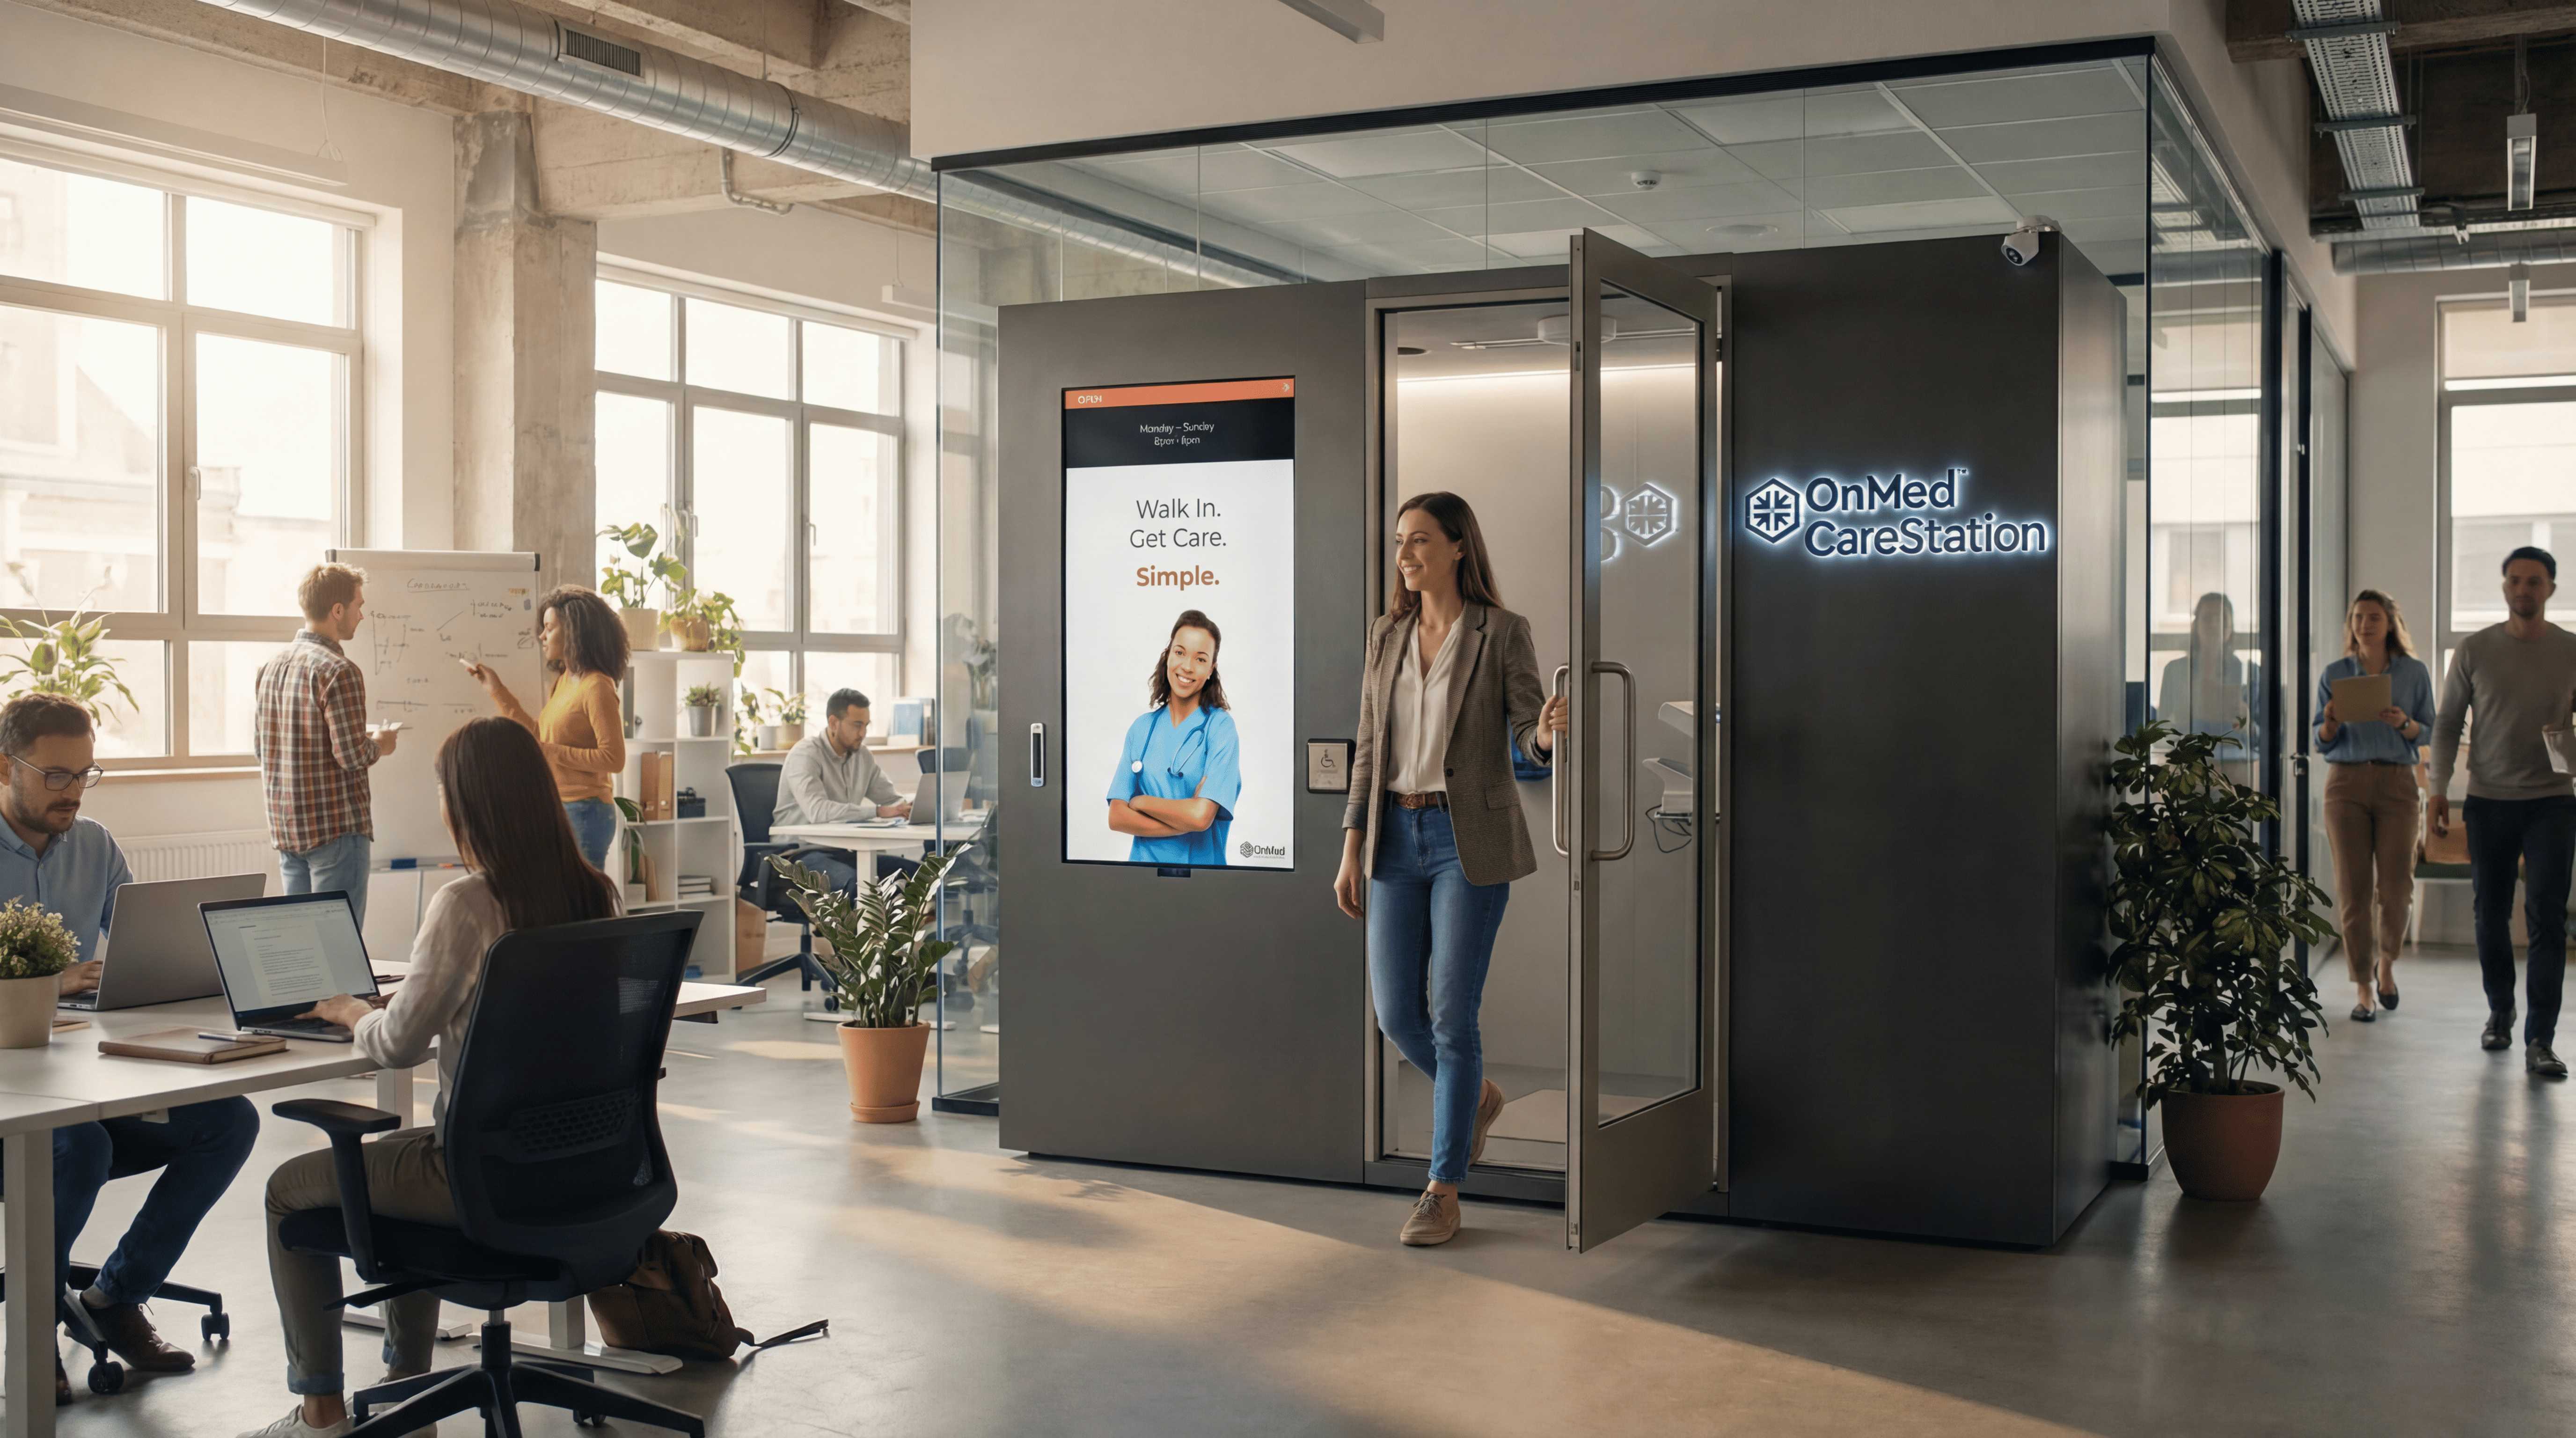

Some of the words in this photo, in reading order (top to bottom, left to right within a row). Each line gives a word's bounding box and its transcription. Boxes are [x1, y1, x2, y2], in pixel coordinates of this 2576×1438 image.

[1136, 498, 1190, 519] Walk
[1197, 498, 1221, 518] In.
[1130, 528, 1166, 548] Get
[1173, 528, 1226, 547] Care.
[1805, 513, 2045, 557] CareStation
[1136, 565, 1220, 591] Simple.
